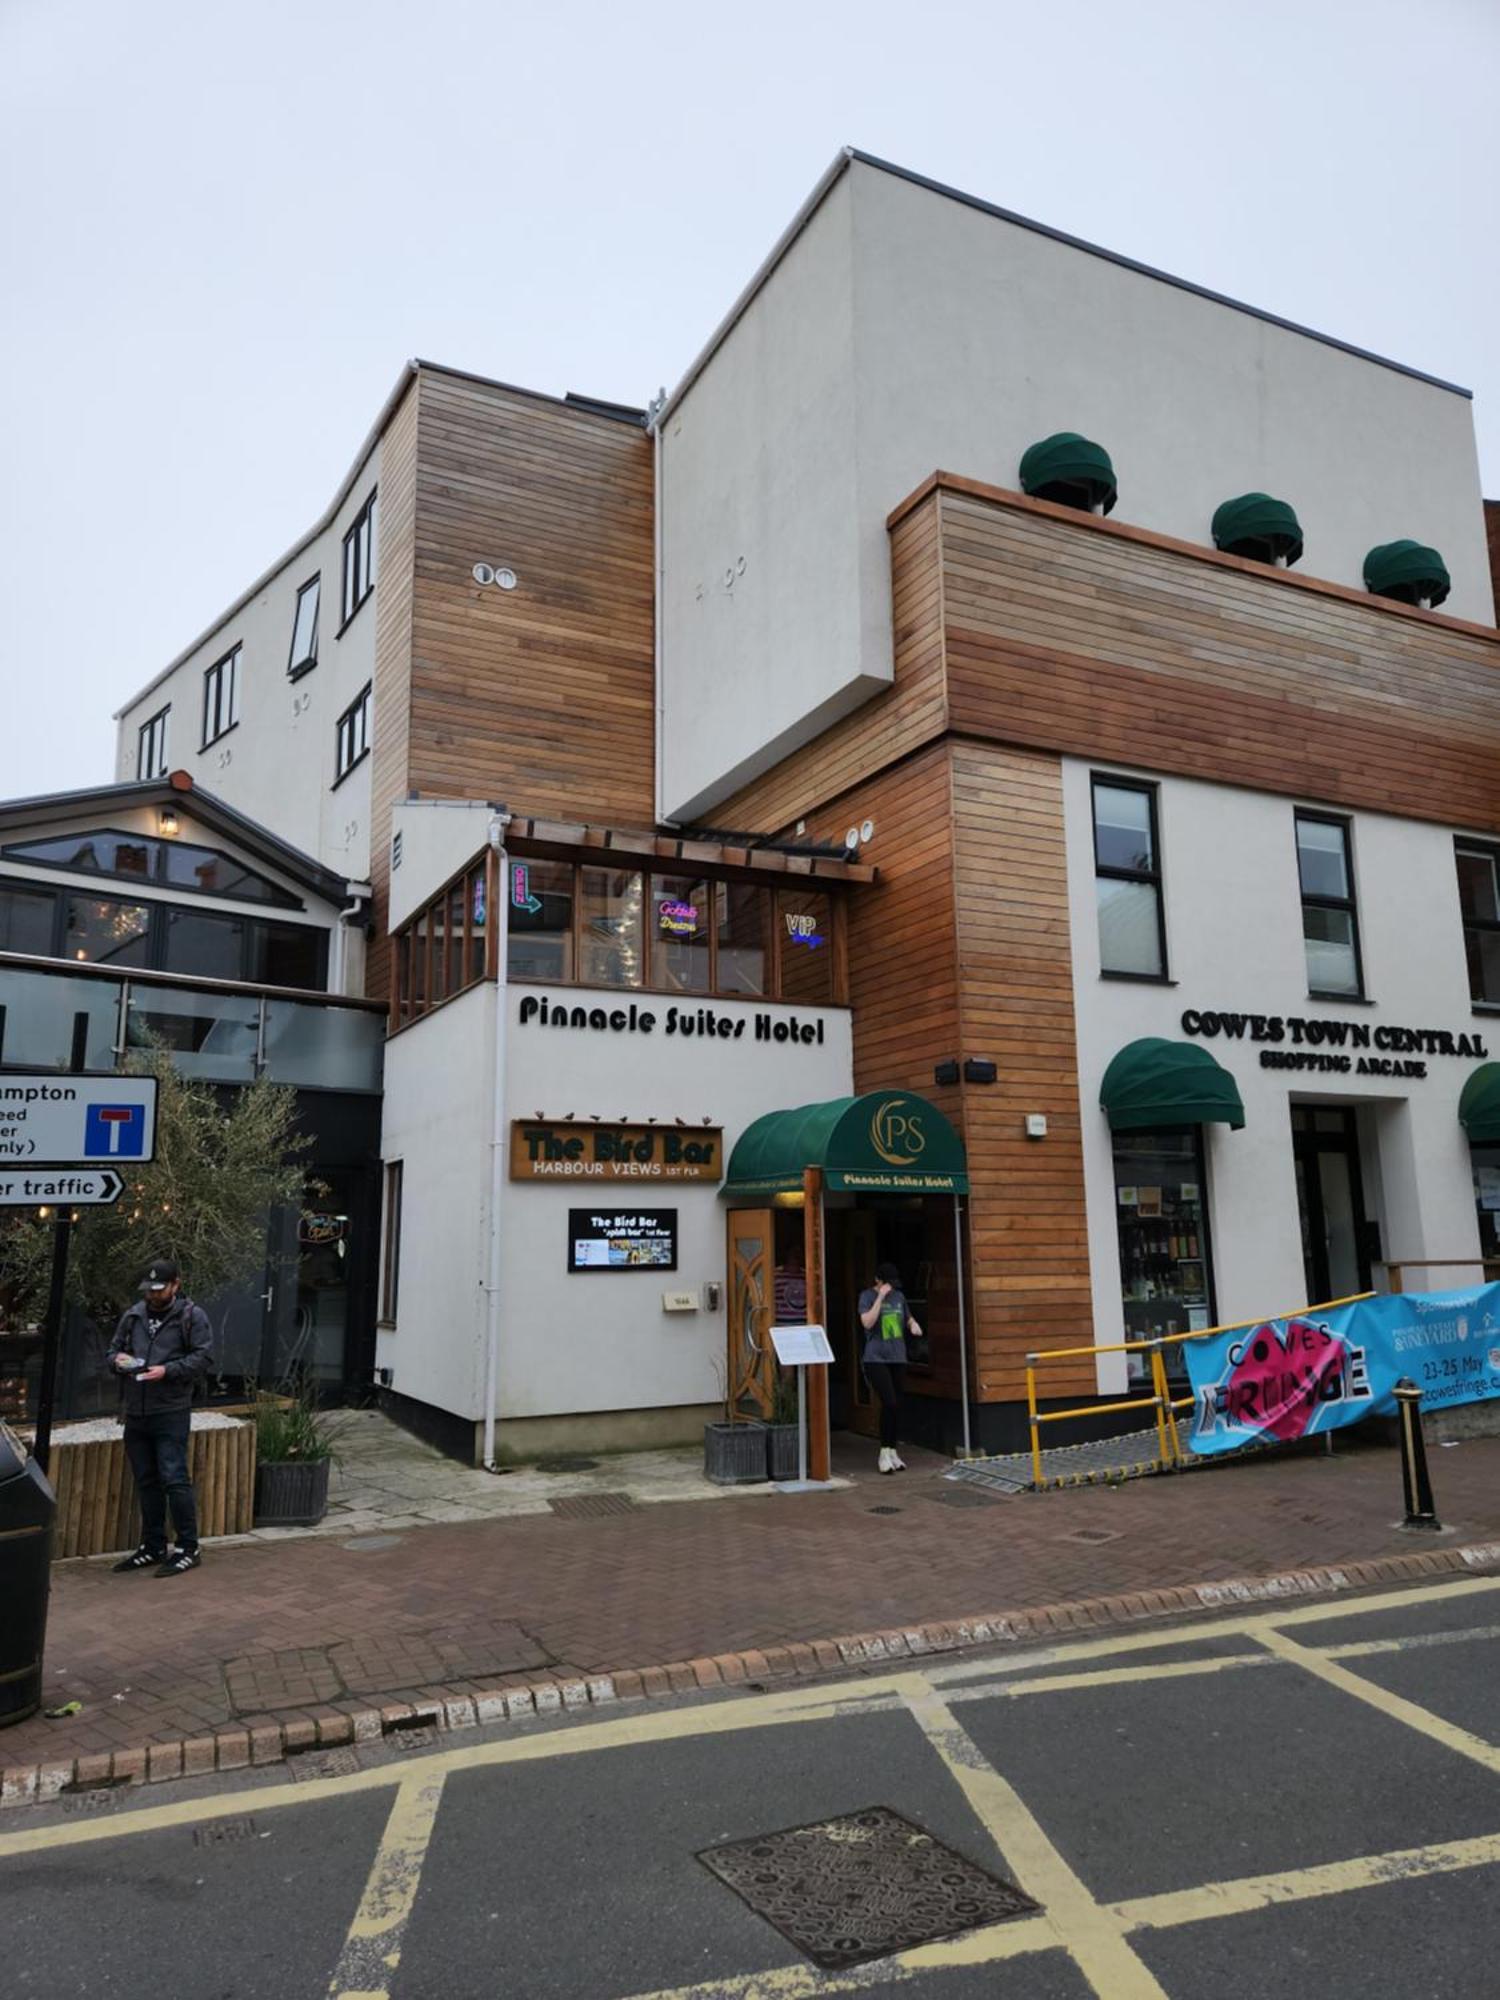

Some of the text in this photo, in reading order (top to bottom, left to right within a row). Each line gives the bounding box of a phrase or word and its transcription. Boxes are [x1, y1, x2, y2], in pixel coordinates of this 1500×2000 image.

[785, 913, 817, 937] VIP
[520, 995, 824, 1044] Pinnacle Suites Hotel
[1181, 1010, 1488, 1058] COWES TOWN CENTRAL
[1259, 1050, 1427, 1078] SHOPPING ARCADE
[0, 1085, 76, 1103] mpton
[524, 1128, 714, 1165] The Bird Bar
[533, 1162, 604, 1174] HARBOUR
[612, 1163, 661, 1175] VIEWS
[843, 1173, 892, 1185] Pinnacle
[924, 1176, 954, 1187] Hotel
[24, 1178, 94, 1195] traffic
[591, 1215, 657, 1227] The Bird Bar
[1229, 1324, 1332, 1367] COWES
[1423, 1359, 1458, 1380] 23-25
[1462, 1356, 1483, 1375] May
[1199, 1349, 1372, 1433] FRINGE
